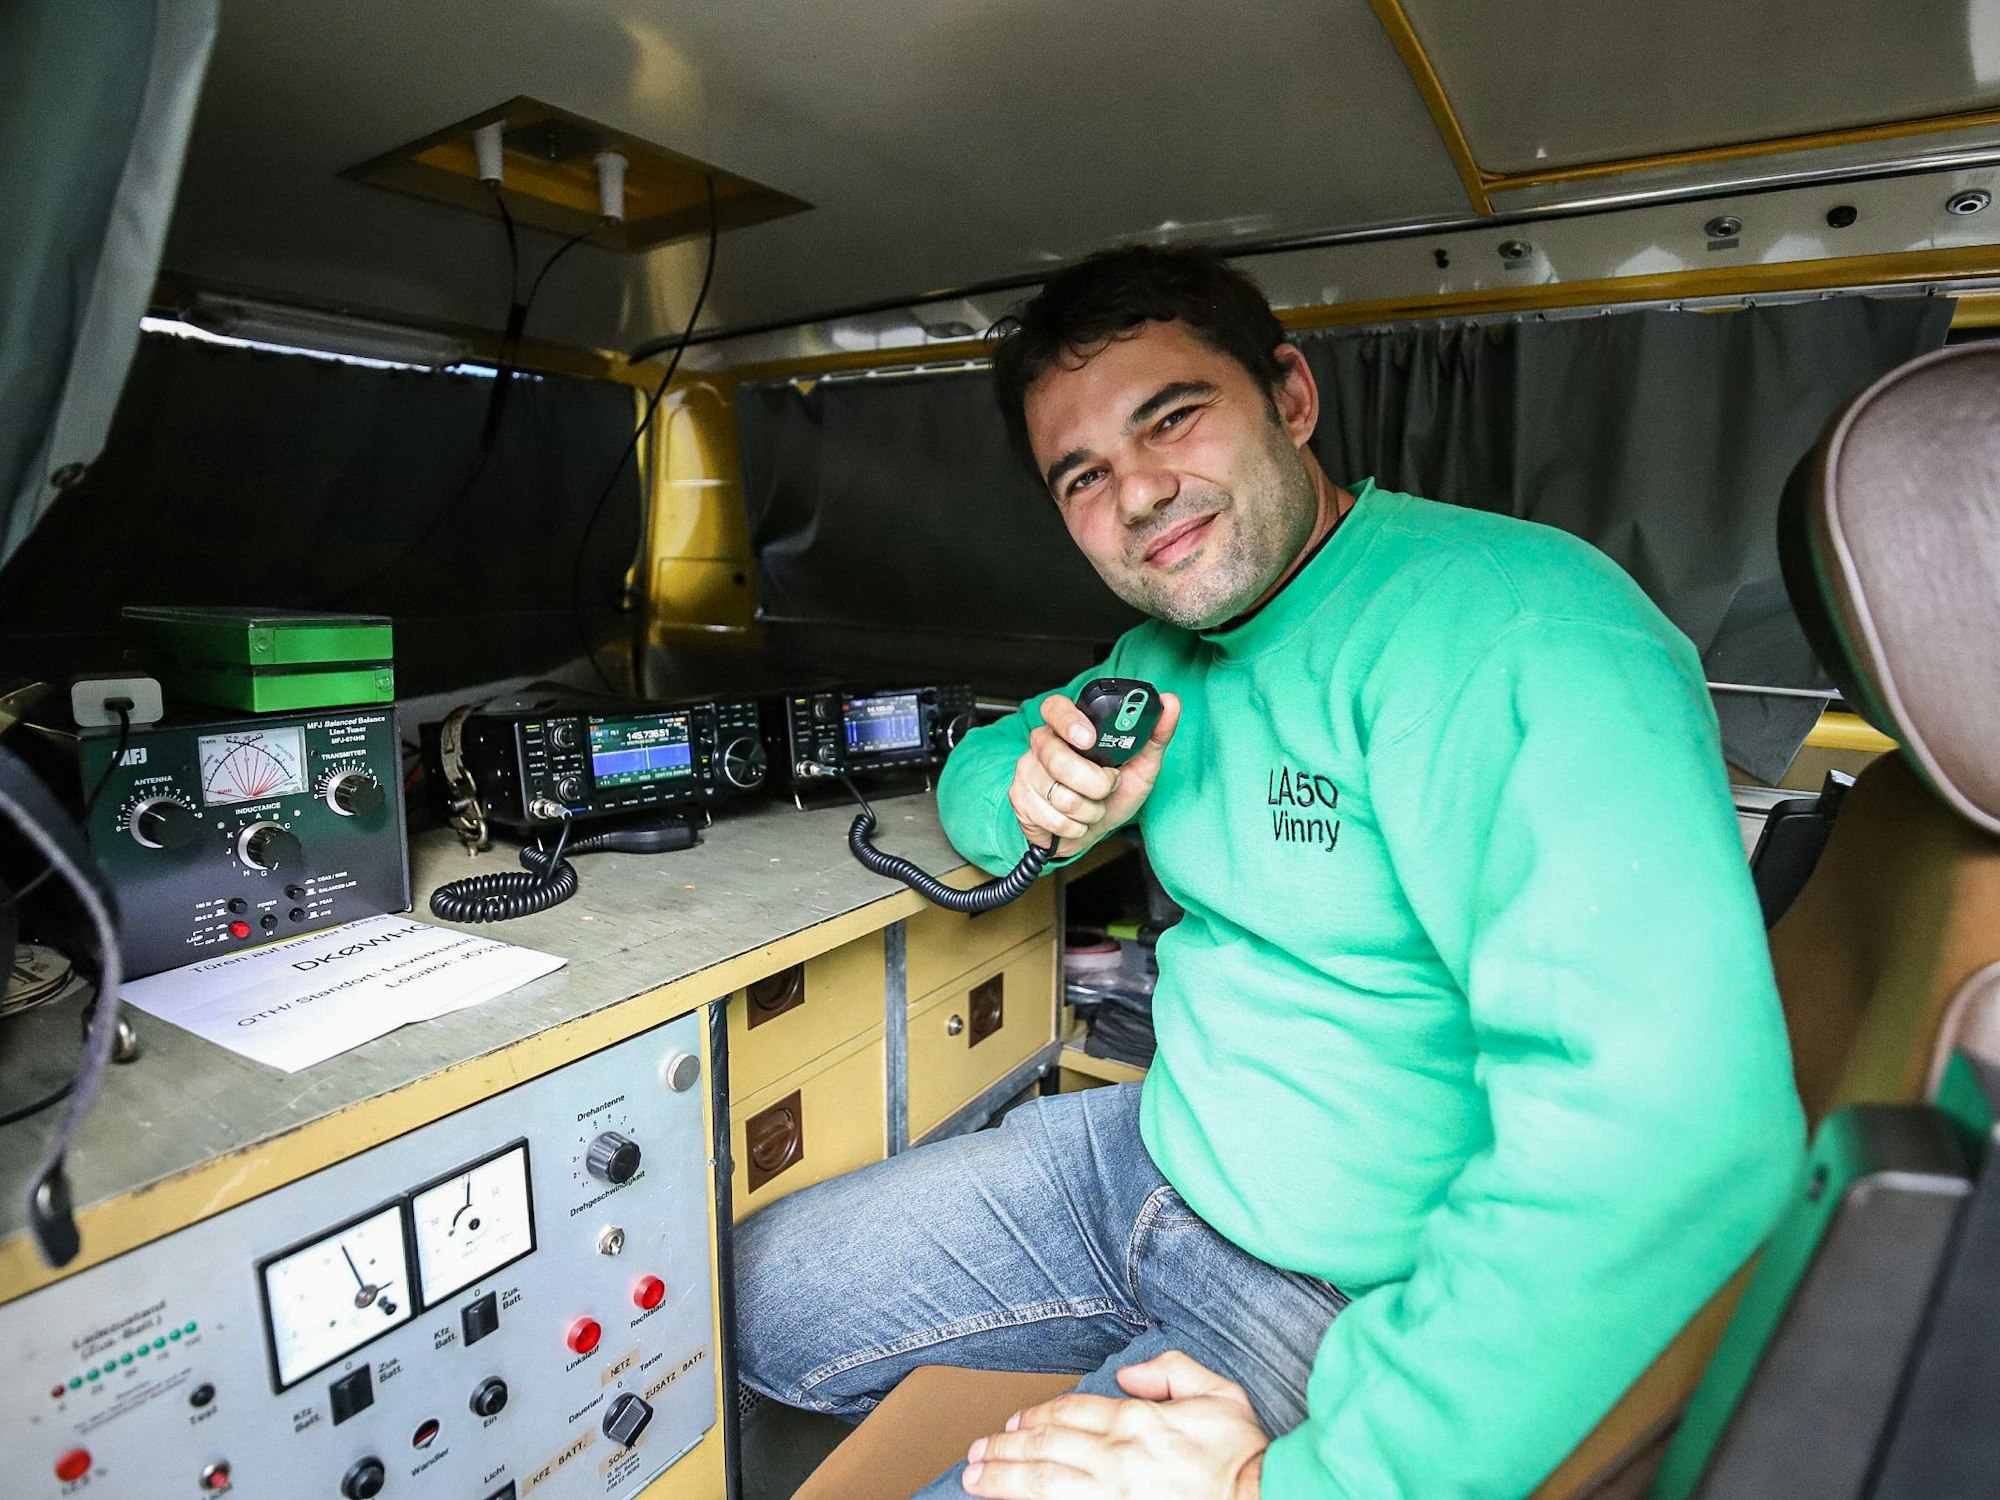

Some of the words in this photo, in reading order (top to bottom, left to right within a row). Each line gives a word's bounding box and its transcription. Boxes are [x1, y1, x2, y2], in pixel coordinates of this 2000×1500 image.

[324, 718, 357, 727] Balanced
[358, 716, 386, 724] Balance
[346, 726, 367, 734] Tuner
[321, 749, 367, 760] TRANSMITTER
[134, 775, 173, 786] ANTENNA
[235, 802, 281, 815] INDUCTANCE
[1273, 810, 1340, 852] Vinny
[319, 884, 345, 893] BALANCED
[257, 900, 278, 908] POWER
[186, 935, 203, 943] LAMP
[189, 955, 247, 973] Türen
[251, 946, 280, 958] auf
[284, 937, 311, 949] mit
[314, 930, 341, 940] der
[296, 972, 381, 1003] Standort:
[381, 938, 478, 972] Leverkusen
[577, 1095, 625, 1121] Drehantenne
[570, 1170, 646, 1217] Drehgeschwindigkeit
[502, 1287, 520, 1301] Zus.
[503, 1294, 523, 1310] Batt.
[631, 1299, 666, 1328] Rechtslauf
[434, 1326, 449, 1340] Kfz
[435, 1333, 458, 1350] Batt.
[566, 1344, 600, 1372] Linkslauf
[610, 1357, 631, 1377] NETZ
[640, 1352, 663, 1372] Tasten
[379, 1365, 403, 1383] Batt.
[645, 1371, 676, 1400] ZUSATZ
[682, 1350, 705, 1372] BATT.
[293, 1407, 312, 1422] Kfz
[568, 1393, 604, 1423] Dauerlauf
[295, 1414, 321, 1433] Batt.
[483, 1415, 497, 1428] Ein
[411, 1447, 449, 1476] Wandler
[533, 1466, 550, 1485] KFZ
[558, 1440, 586, 1465] BATT.
[484, 1464, 505, 1484] Licht
